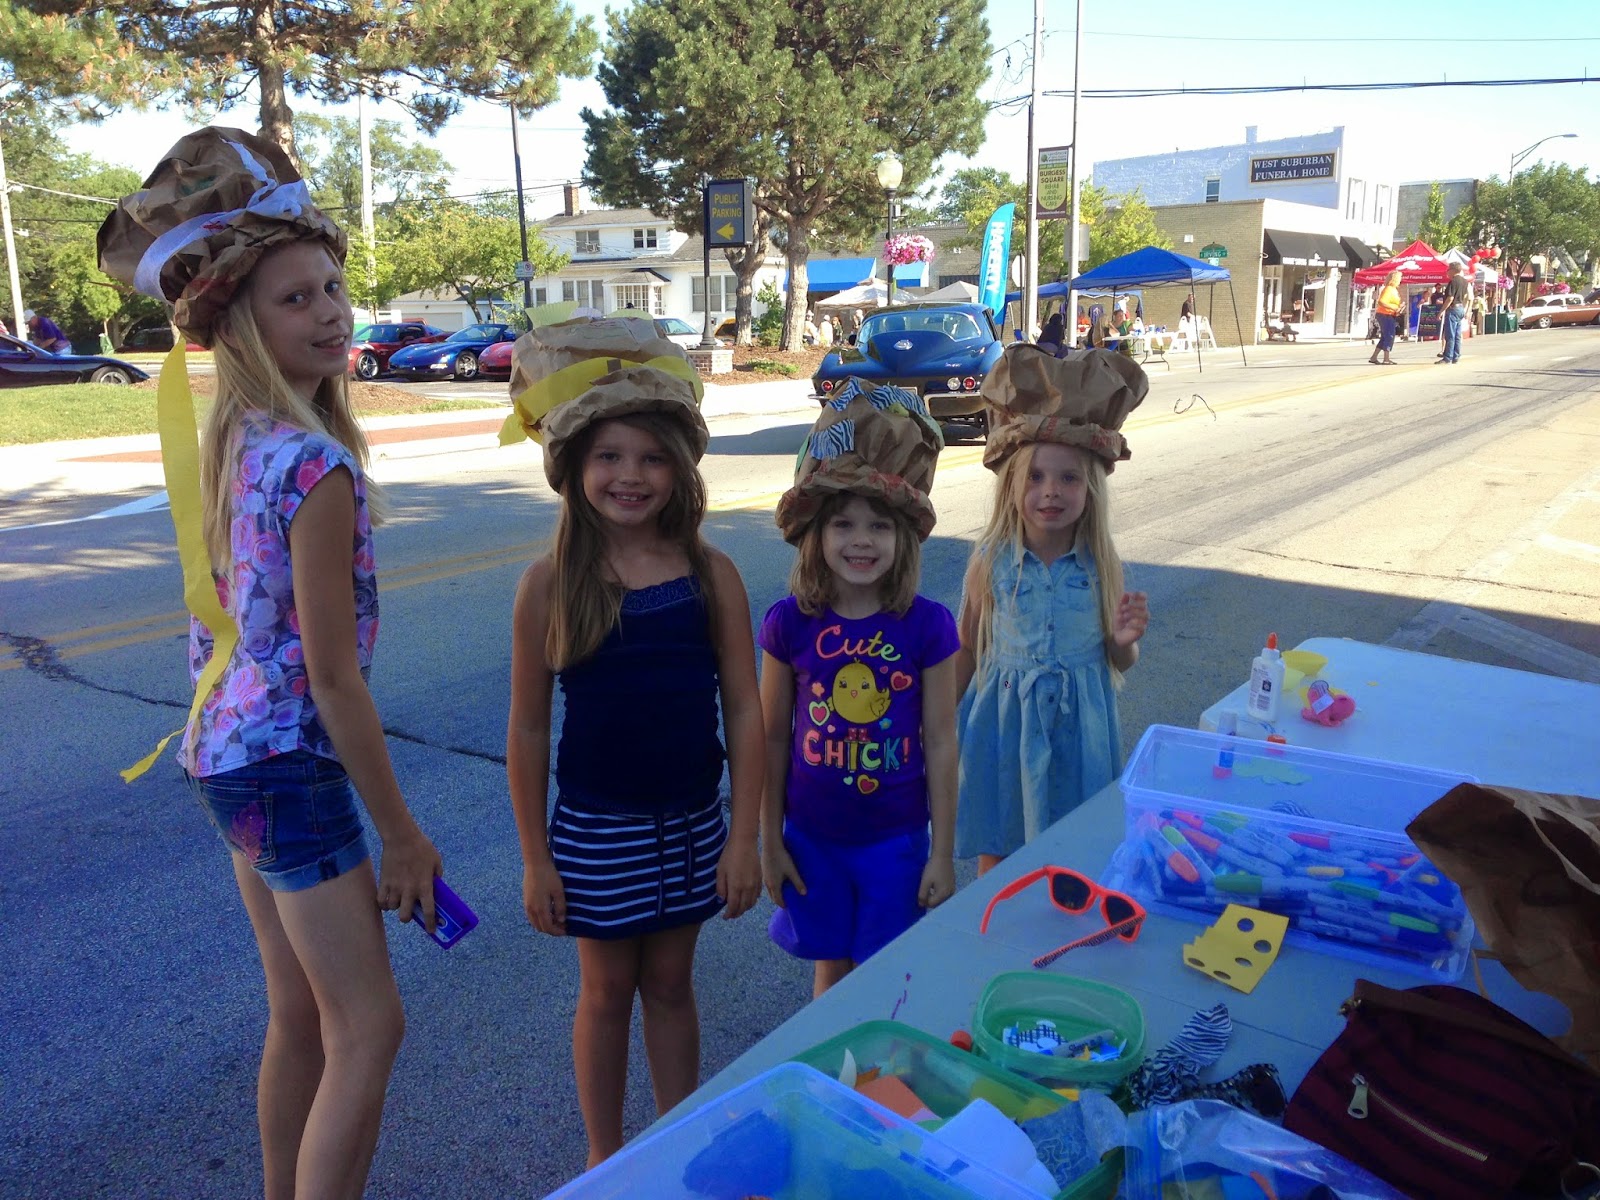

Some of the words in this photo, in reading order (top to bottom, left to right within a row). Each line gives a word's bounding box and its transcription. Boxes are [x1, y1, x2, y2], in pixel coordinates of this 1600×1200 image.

[1253, 160, 1279, 169] WEST
[1280, 155, 1333, 167] SUBURBAN
[1039, 169, 1066, 177] BURGESS
[1255, 170, 1299, 181] FUNERAL
[1301, 167, 1330, 177] HOME
[714, 193, 739, 204] PUBLIC
[711, 207, 742, 218] PARKING
[985, 221, 1006, 294] HAGERTY
[815, 624, 901, 662] Cute
[803, 729, 910, 773] CHICK!
